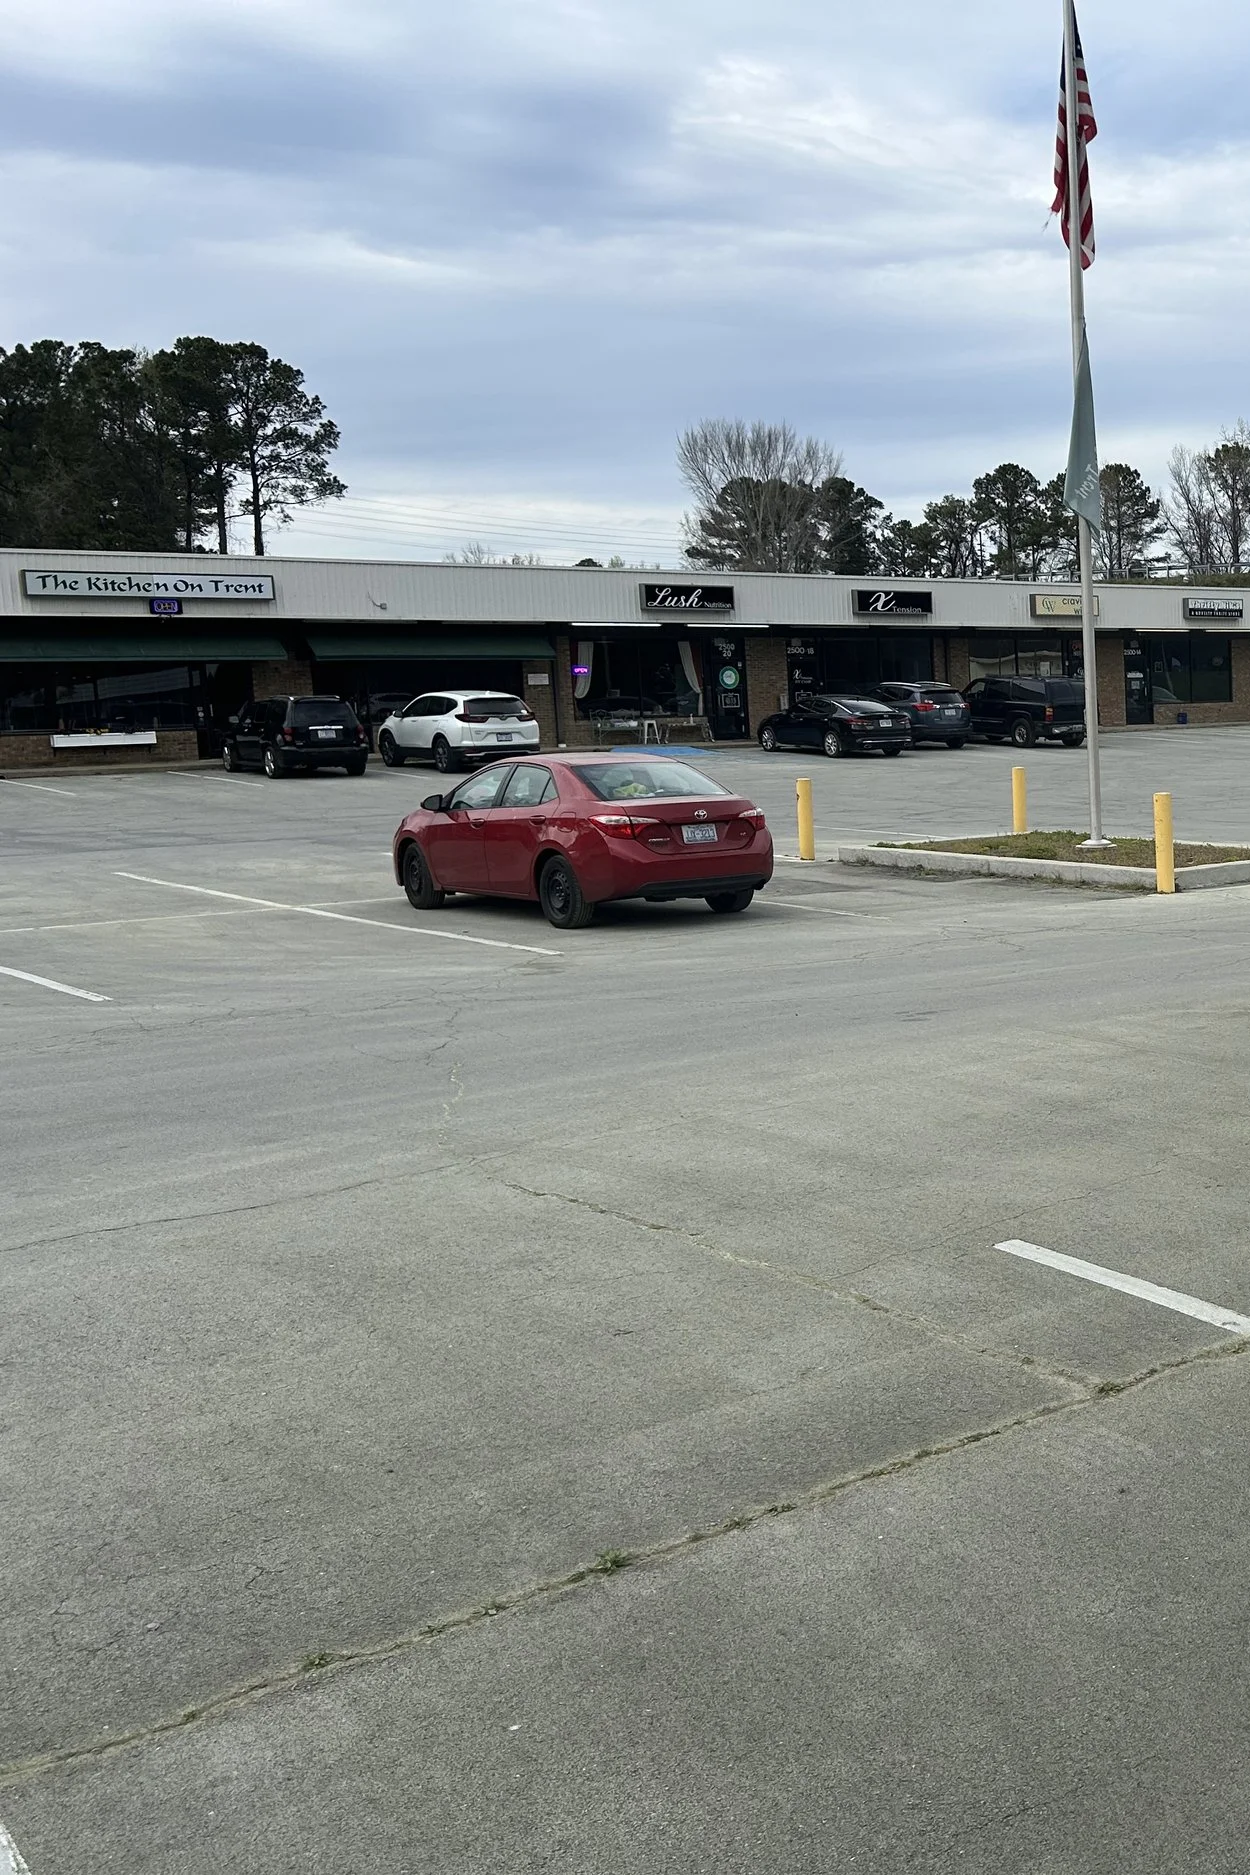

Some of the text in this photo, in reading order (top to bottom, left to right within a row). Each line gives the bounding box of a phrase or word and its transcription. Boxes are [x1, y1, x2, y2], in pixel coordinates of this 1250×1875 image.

[35, 574, 265, 594] The Kitchen On Trent
[647, 587, 732, 609] Lush Nutrition
[893, 605, 922, 613] Tension
